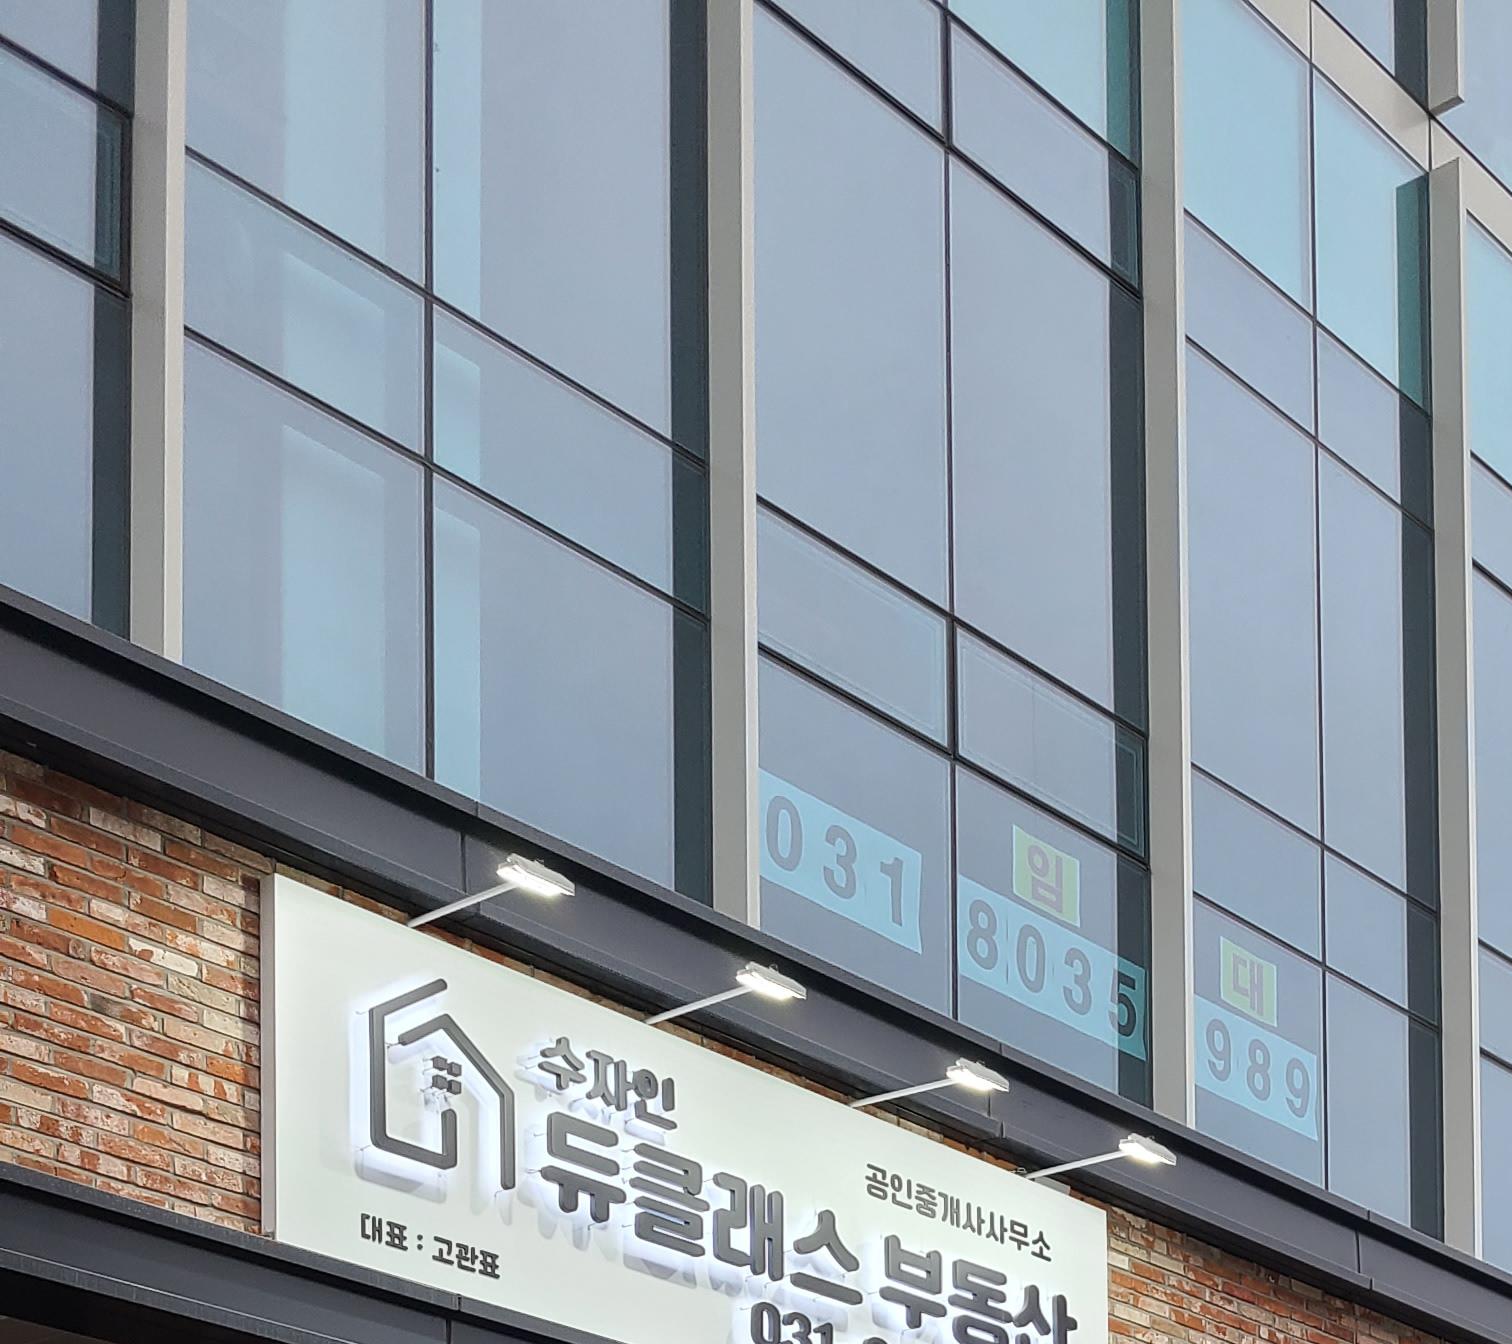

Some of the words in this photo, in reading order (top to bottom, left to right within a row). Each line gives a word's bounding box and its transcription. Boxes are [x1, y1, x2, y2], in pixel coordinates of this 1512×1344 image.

[765, 795, 905, 927] 031
[966, 899, 1138, 1037] 8035
[1205, 1018, 1311, 1118] 989
[1026, 843, 1064, 915] 임
[1231, 956, 1265, 1018] 대
[538, 1036, 676, 1131] 수자인
[359, 1211, 409, 1253] 대표
[432, 1236, 501, 1280] 고관표
[540, 1111, 864, 1307] 듀클래스
[864, 1163, 1052, 1263] 공인중개사사무소
